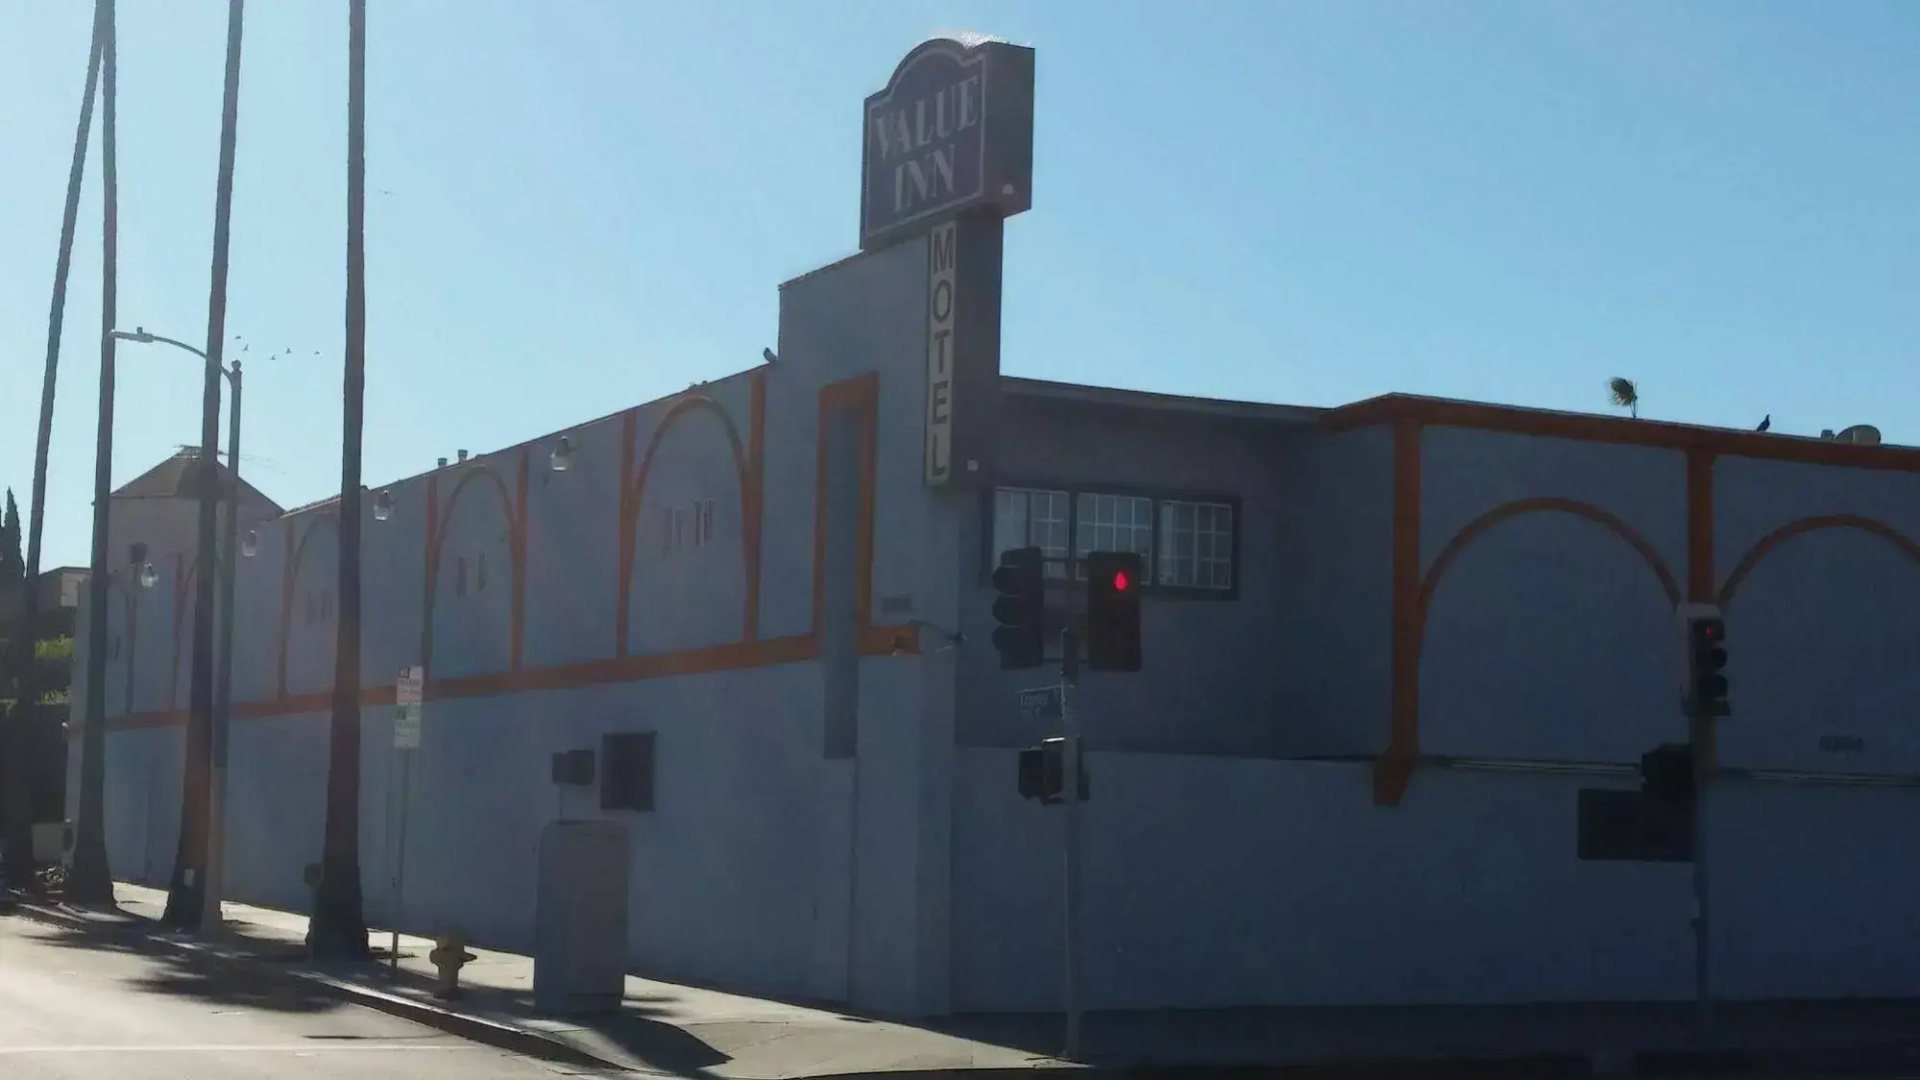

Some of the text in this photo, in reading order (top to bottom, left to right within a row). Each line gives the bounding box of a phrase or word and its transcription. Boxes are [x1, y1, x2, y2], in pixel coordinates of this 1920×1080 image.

[876, 75, 979, 160] VALUE
[892, 144, 955, 213] INN
[931, 227, 954, 477] MOTEL
